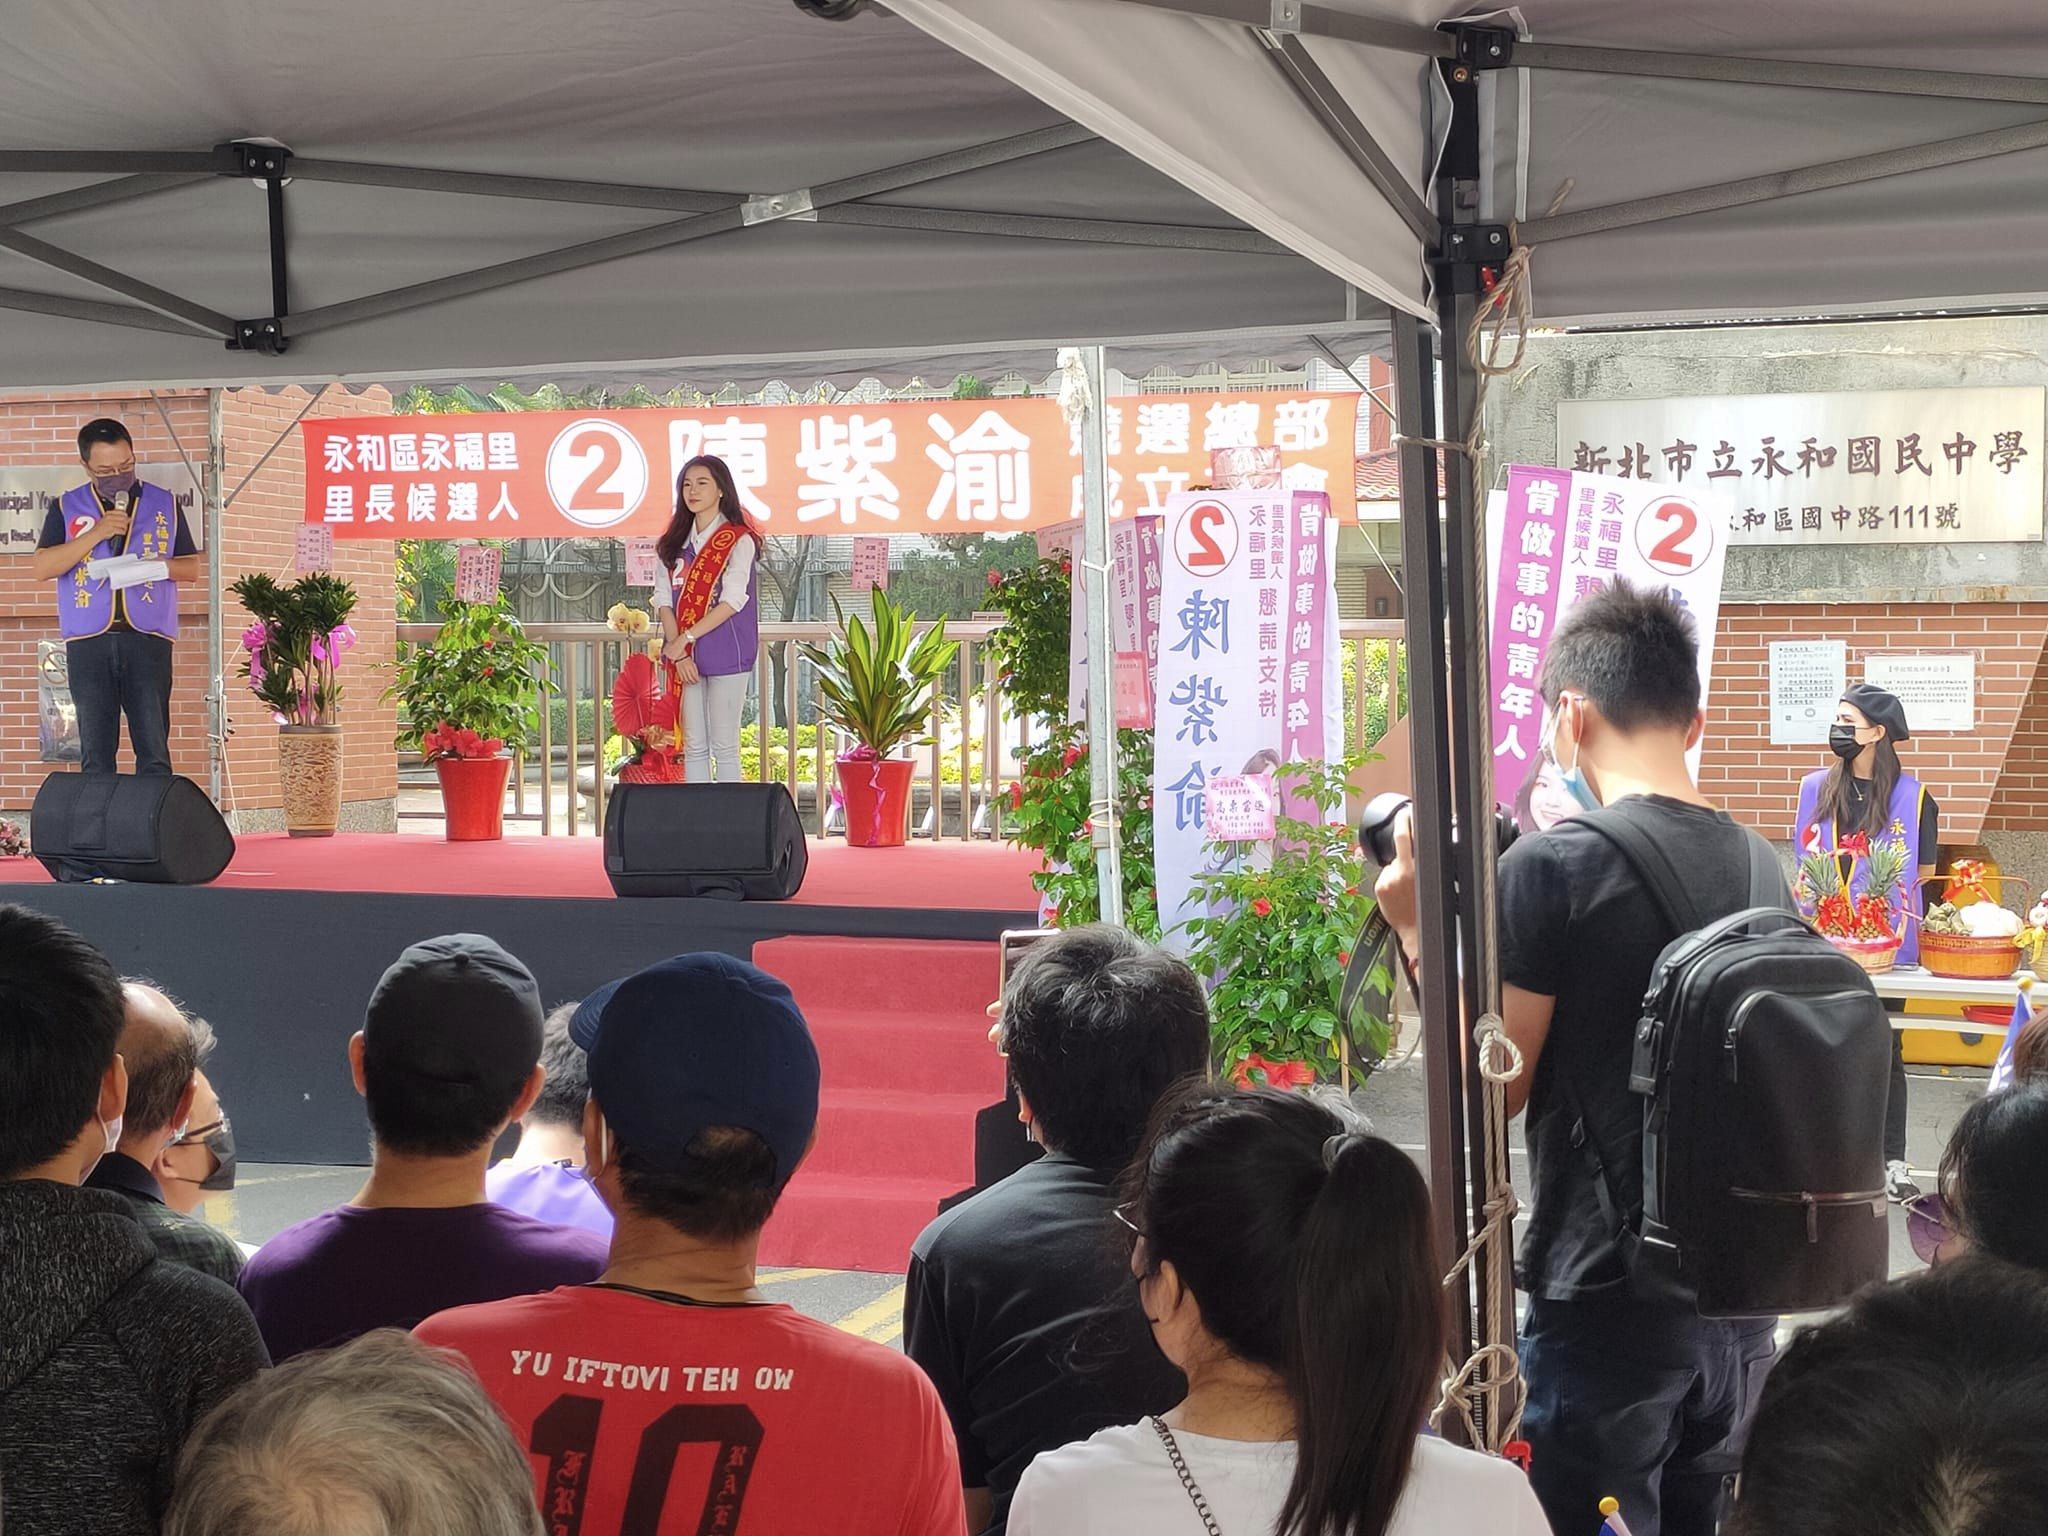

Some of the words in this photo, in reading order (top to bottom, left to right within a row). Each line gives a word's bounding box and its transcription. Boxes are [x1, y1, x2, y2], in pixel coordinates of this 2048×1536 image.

[323, 431, 520, 474] 永和區永福里
[567, 430, 625, 511] 2
[668, 410, 1031, 523] 陳紫渝
[1572, 431, 2027, 481] 新北市立永和國民中學
[323, 481, 520, 523] 里長候選人
[1070, 462, 1329, 518] 成立會
[1728, 503, 1961, 533] 和區國中路111號
[1571, 487, 1596, 567] 里長候選人
[1595, 491, 1624, 570] 永福里
[1649, 502, 1698, 567] 2
[1494, 480, 1561, 760] 肯做事的青年人
[511, 1350, 552, 1376] YU
[563, 1356, 670, 1392] IFTOVI
[682, 1366, 739, 1392] TEH
[754, 1367, 794, 1390] OW
[530, 1393, 765, 1536] 10
